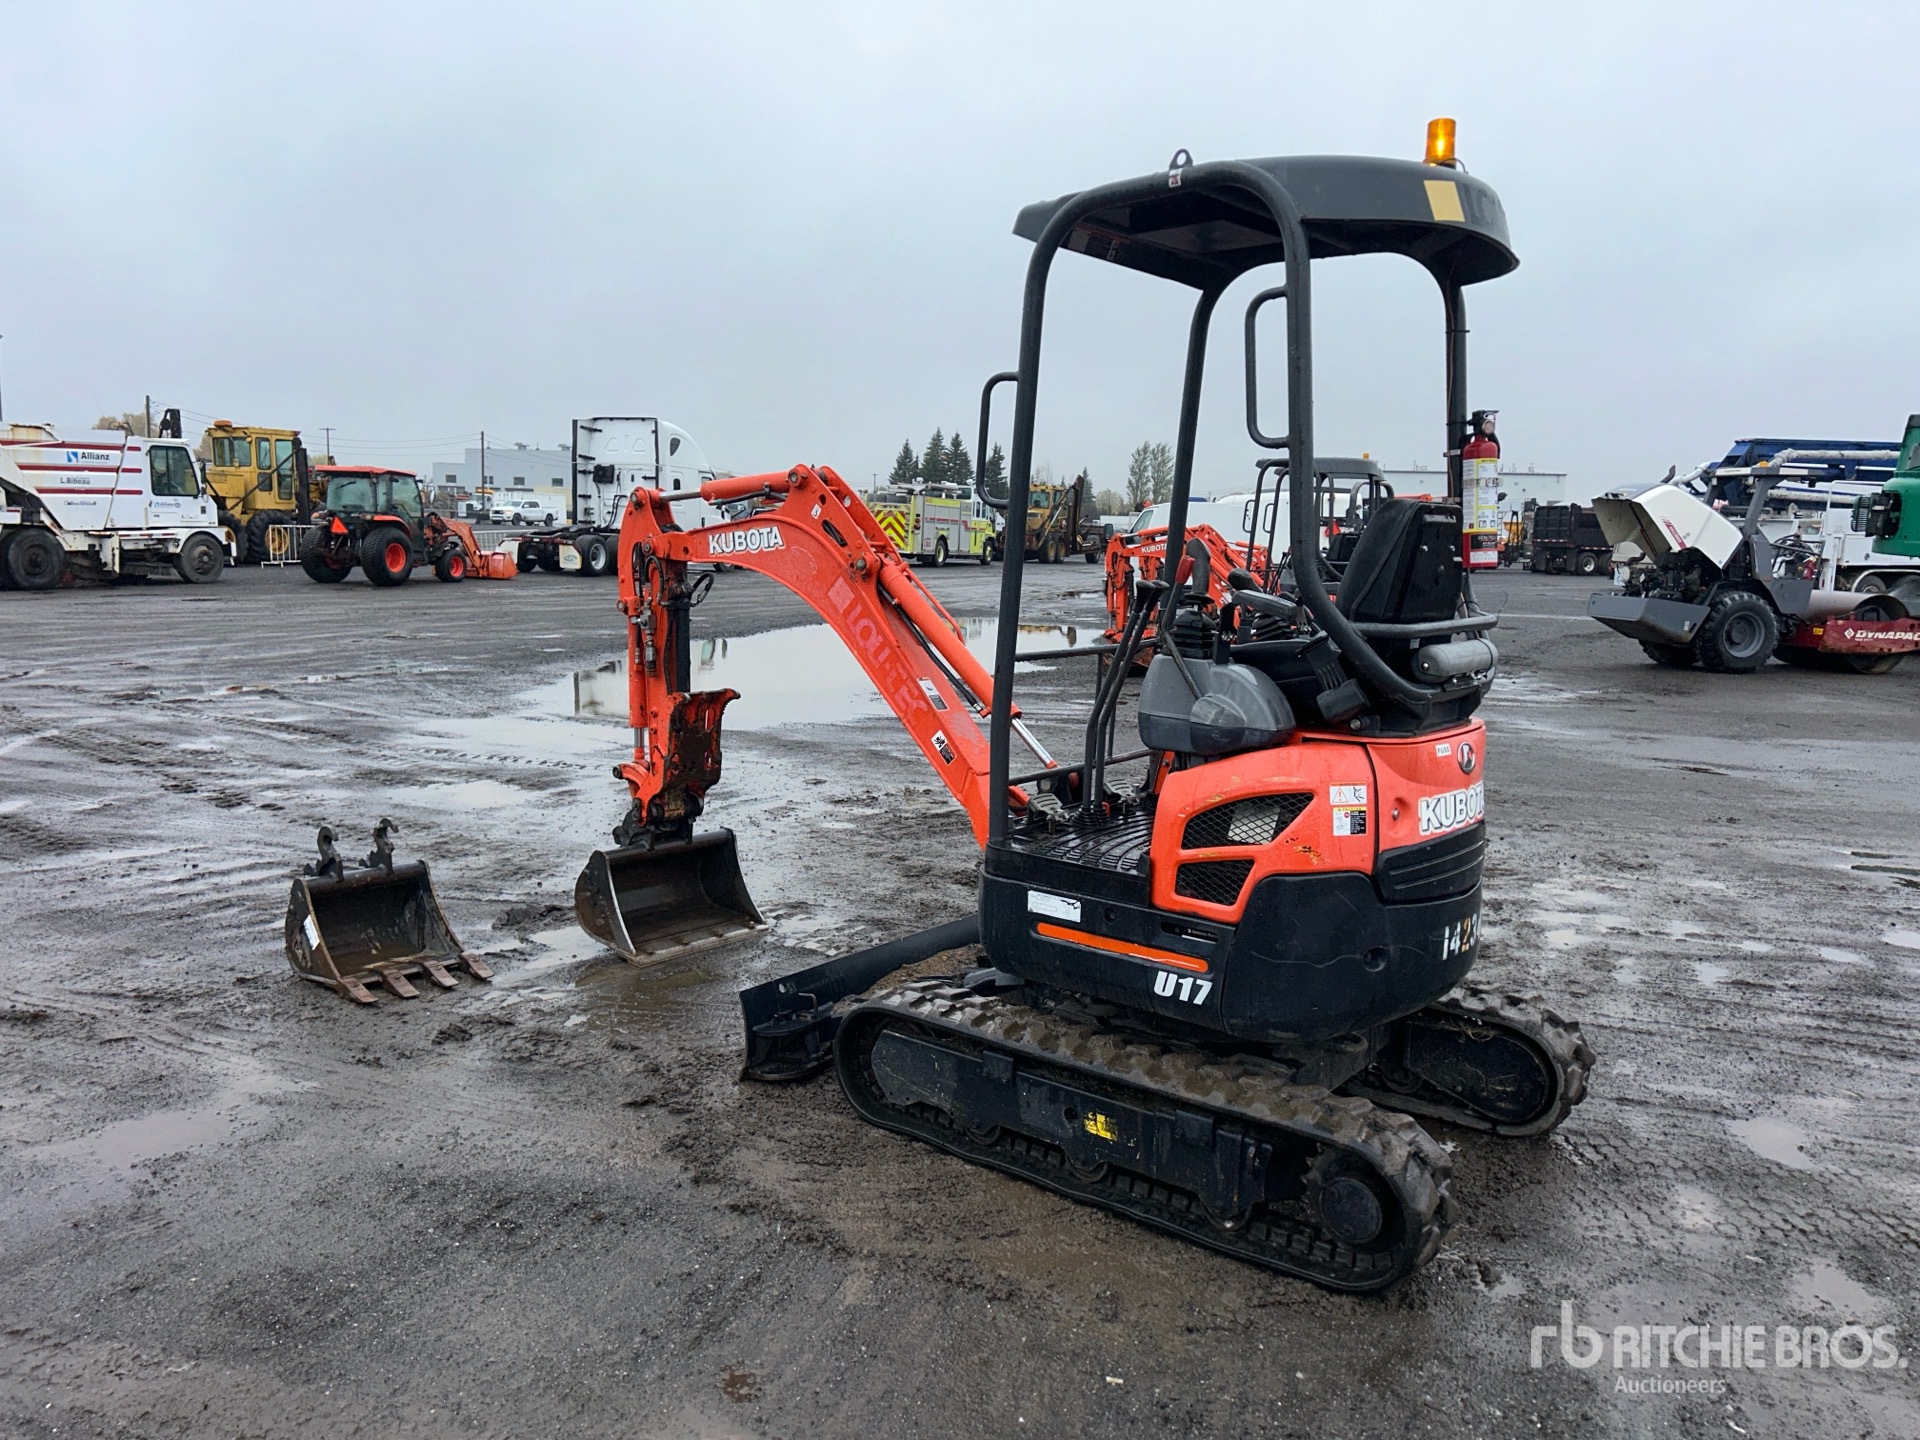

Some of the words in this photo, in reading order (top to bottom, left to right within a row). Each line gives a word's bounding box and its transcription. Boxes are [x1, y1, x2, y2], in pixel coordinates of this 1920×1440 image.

[81, 451, 110, 460] Allianz
[708, 525, 784, 555] KUBOTA
[1419, 782, 1484, 833] KUBOT
[1154, 970, 1213, 1006] U17
